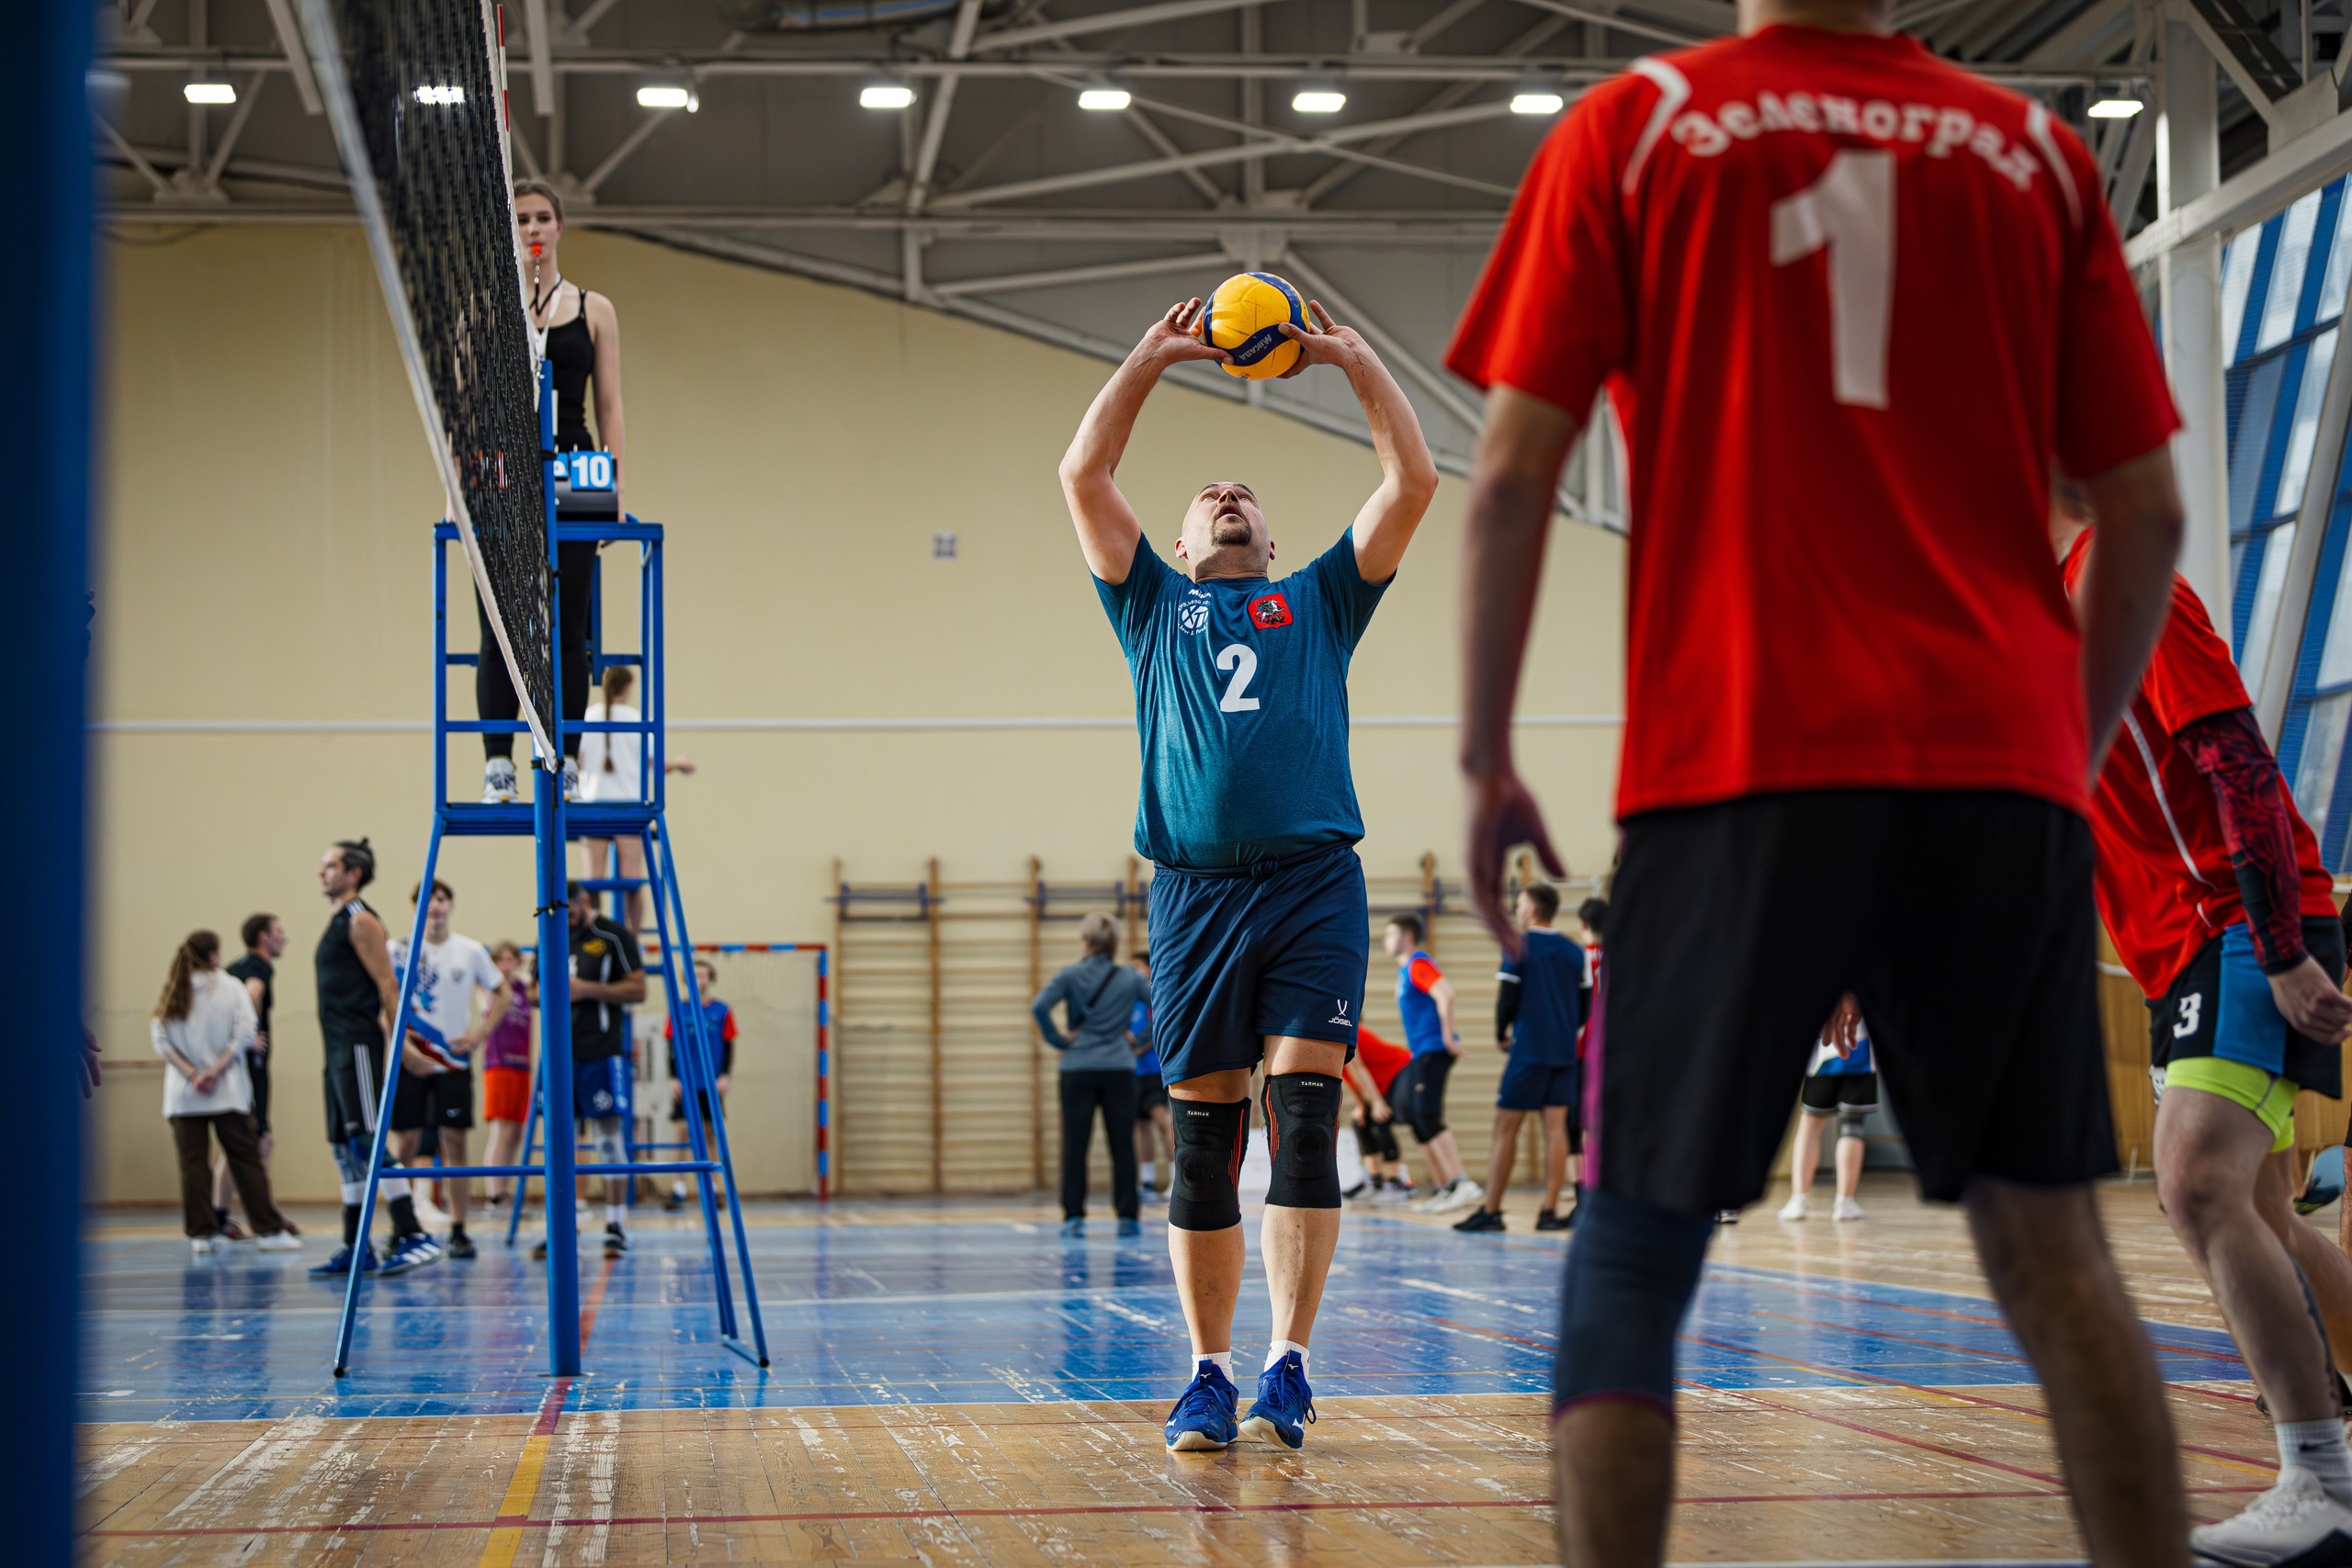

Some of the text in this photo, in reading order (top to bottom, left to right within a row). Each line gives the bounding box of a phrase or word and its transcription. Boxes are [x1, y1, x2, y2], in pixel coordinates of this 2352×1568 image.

[1770, 151, 1895, 410] 1
[571, 455, 611, 488] 10
[1216, 643, 1261, 713] 2
[1328, 1016, 1353, 1027] JÖGEL
[2172, 991, 2202, 1039] 3
